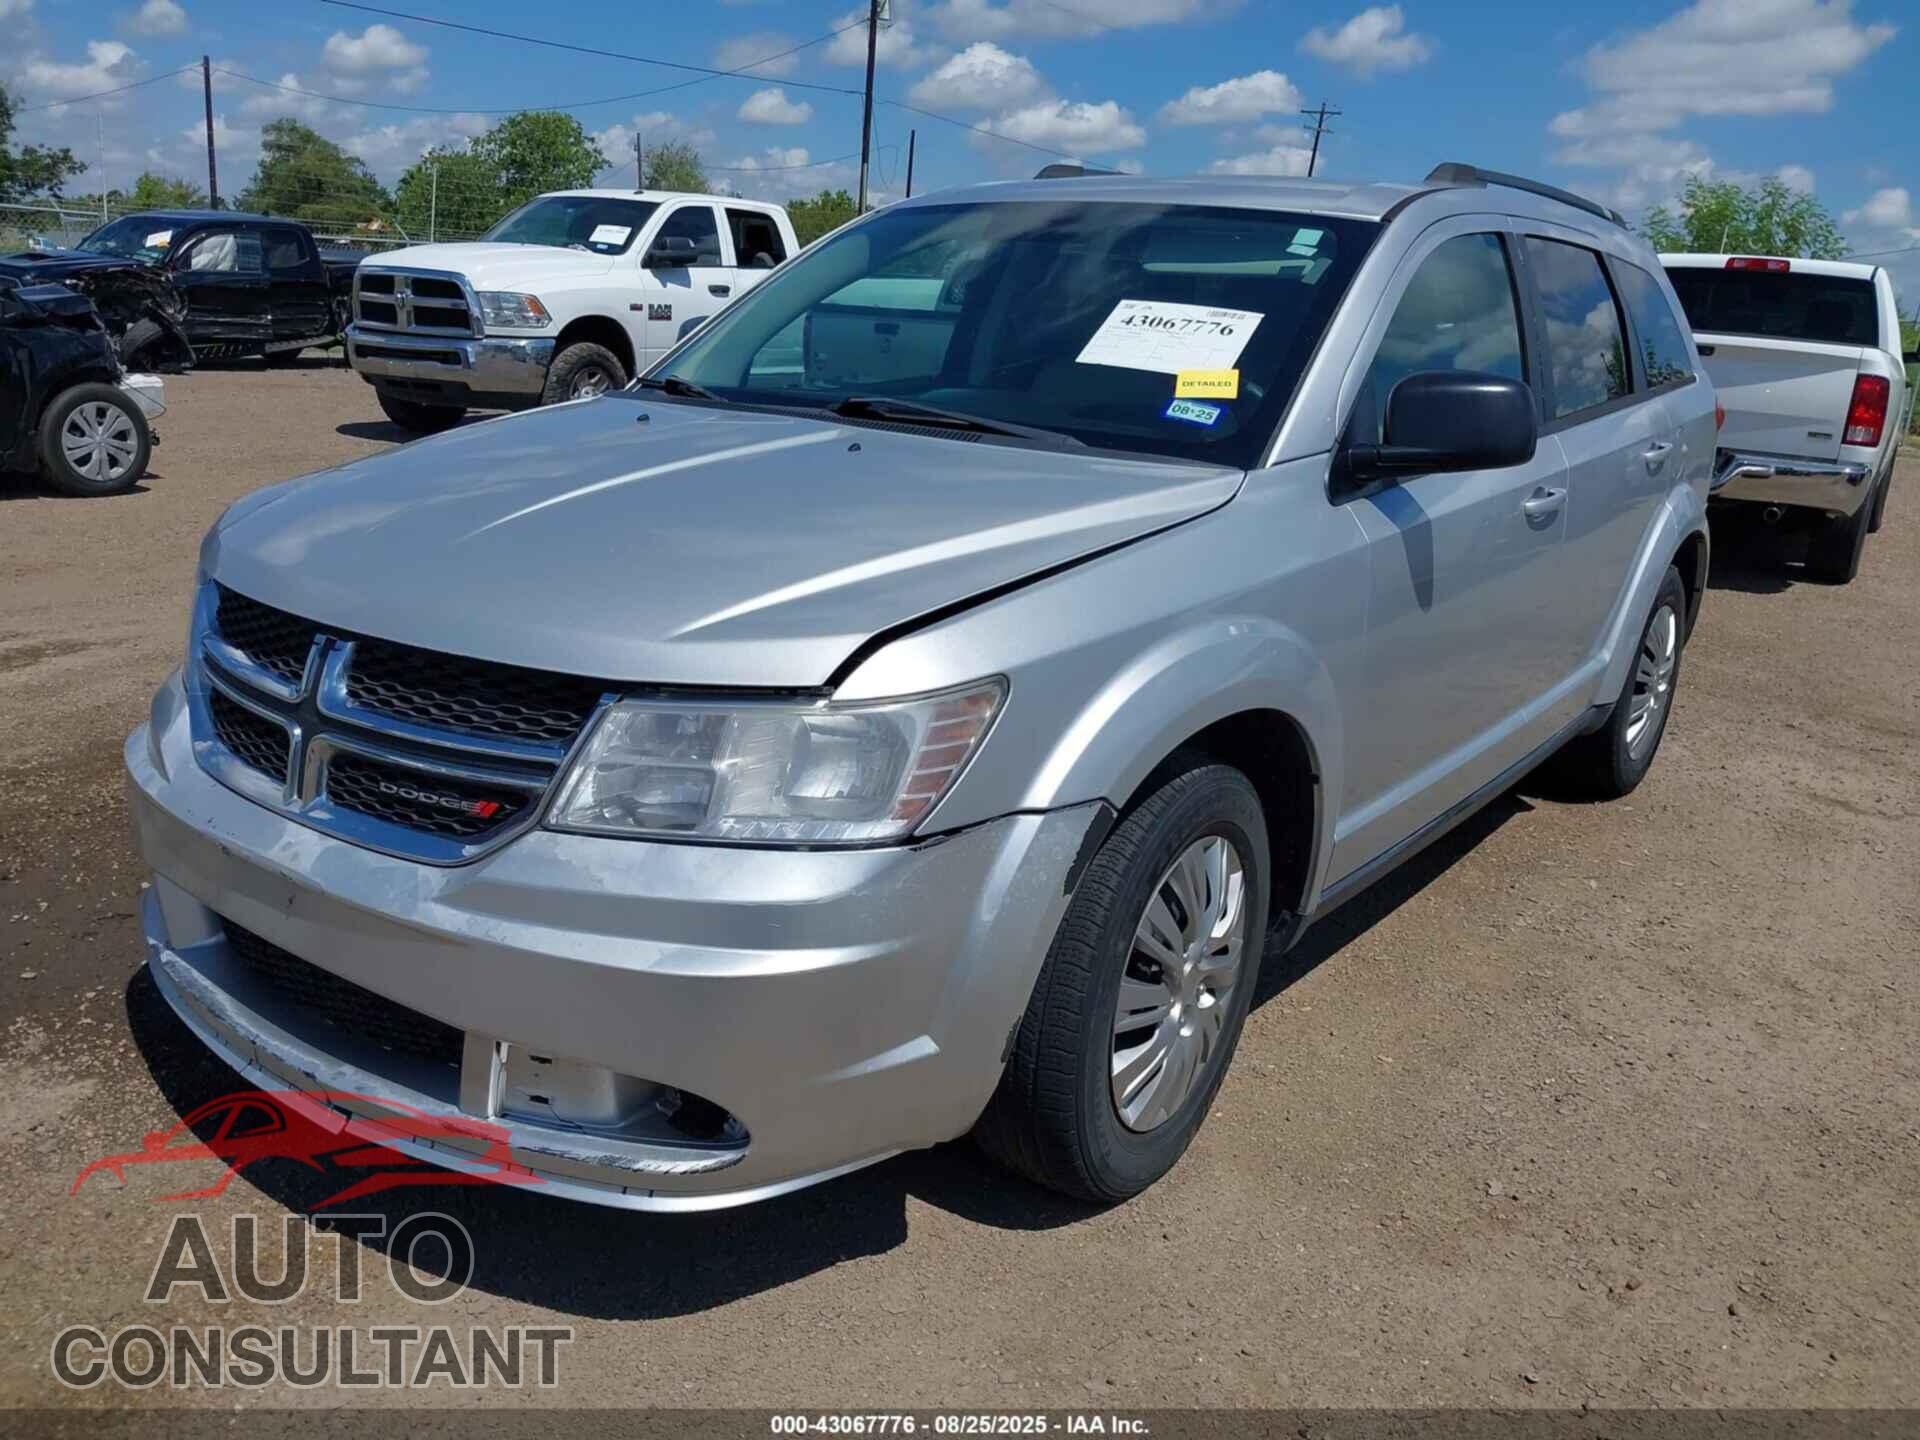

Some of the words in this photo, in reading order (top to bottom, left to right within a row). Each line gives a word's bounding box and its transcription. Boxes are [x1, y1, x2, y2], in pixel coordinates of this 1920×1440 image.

[1120, 314, 1234, 337] 43067776
[1181, 380, 1232, 388] DETAILED
[379, 782, 482, 812] DODGE
